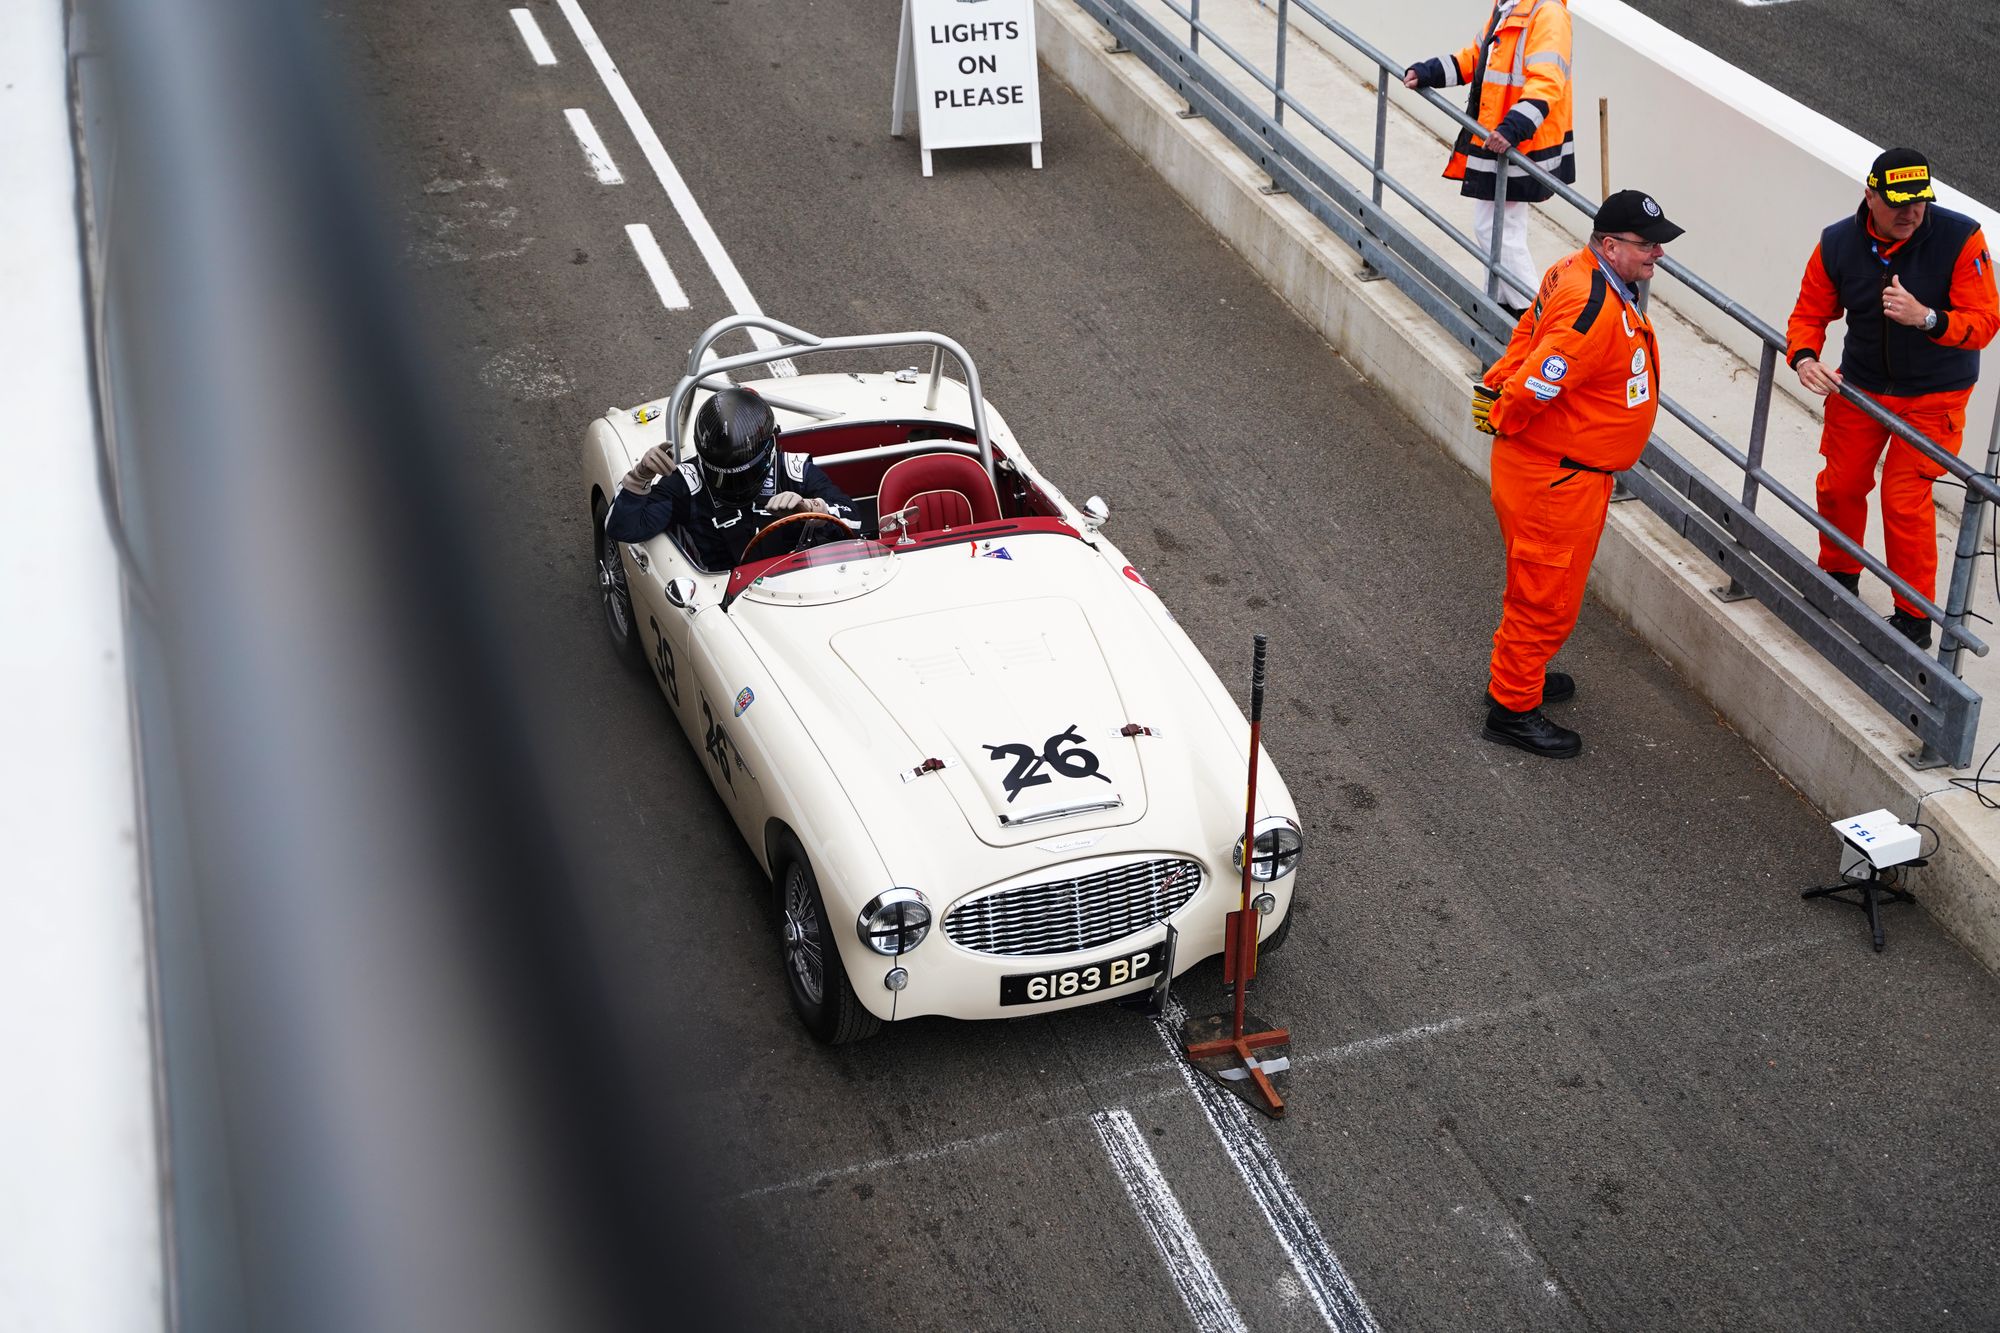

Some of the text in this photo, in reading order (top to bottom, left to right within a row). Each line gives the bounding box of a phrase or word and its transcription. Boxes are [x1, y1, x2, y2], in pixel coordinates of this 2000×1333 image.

[930, 21, 1019, 44] LIGHTS
[958, 55, 997, 75] ON
[934, 85, 1024, 109] PLEASE
[1889, 168, 1926, 181] PIRELLI
[1546, 362, 1563, 376] TIGA
[1527, 379, 1558, 394] CATACLEAN
[732, 463, 751, 474] MOSS
[700, 692, 735, 794] 26
[982, 724, 1112, 804] 26
[1849, 823, 1876, 843] TSL
[1026, 952, 1151, 1001] 6183 BP
